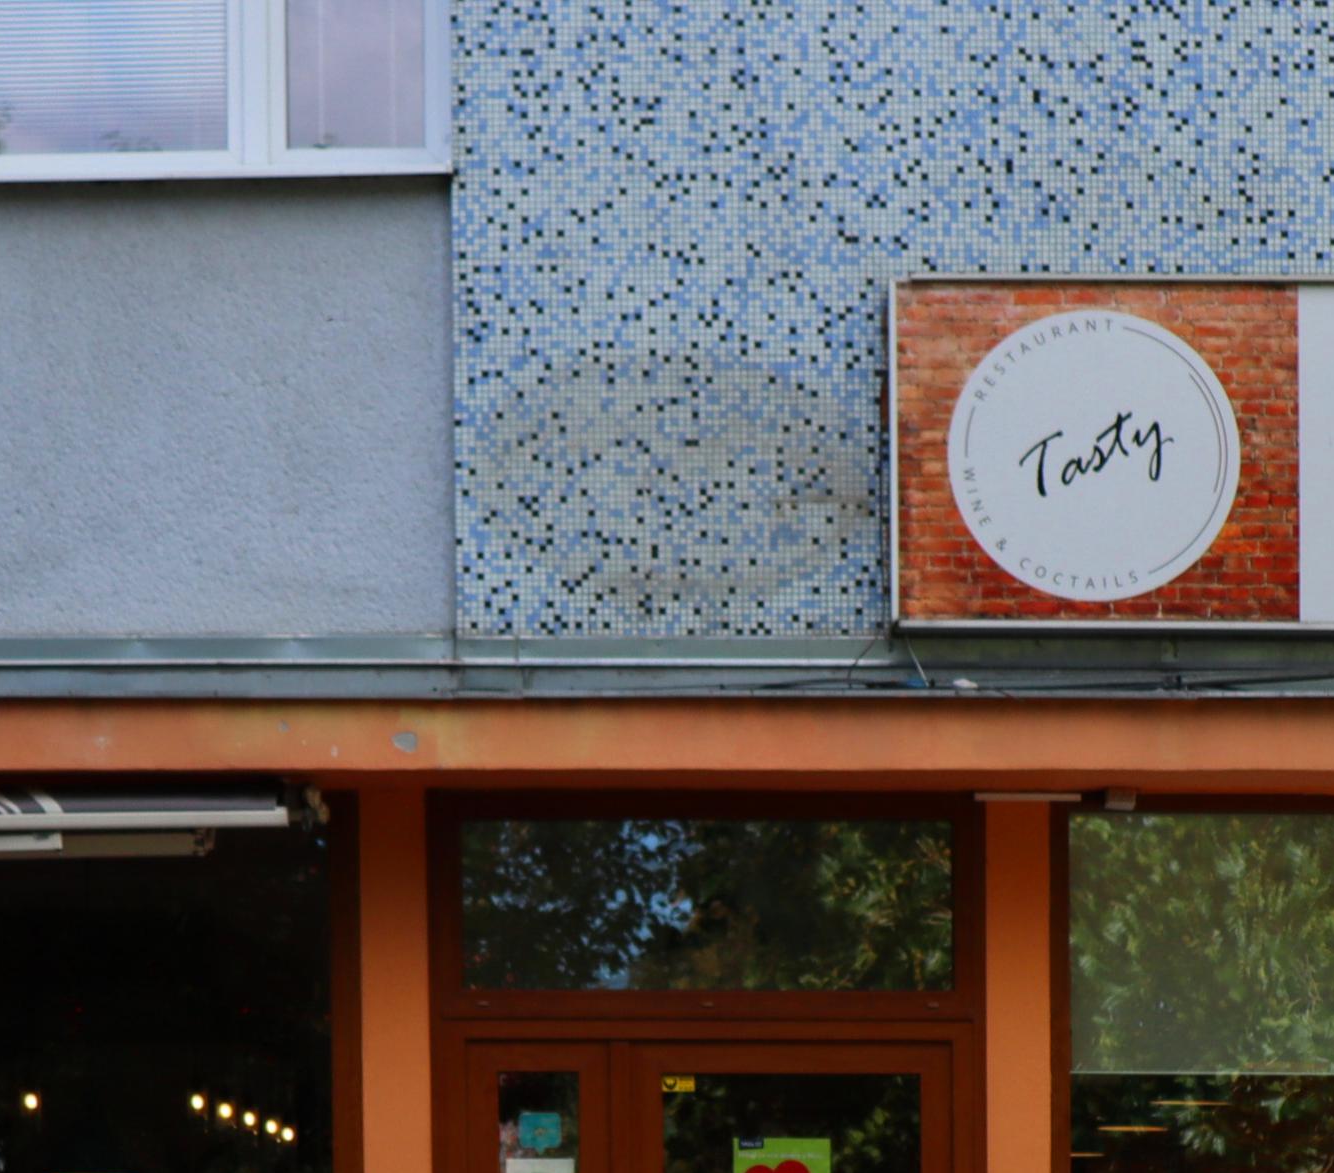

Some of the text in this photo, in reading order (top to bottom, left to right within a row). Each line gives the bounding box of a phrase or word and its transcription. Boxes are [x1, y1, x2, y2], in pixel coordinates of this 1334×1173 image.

[972, 317, 1115, 402] RESTAURANT
[1019, 412, 1173, 497] Tasty
[961, 466, 994, 528] WINE
[1017, 557, 1141, 593] COCTAILS
